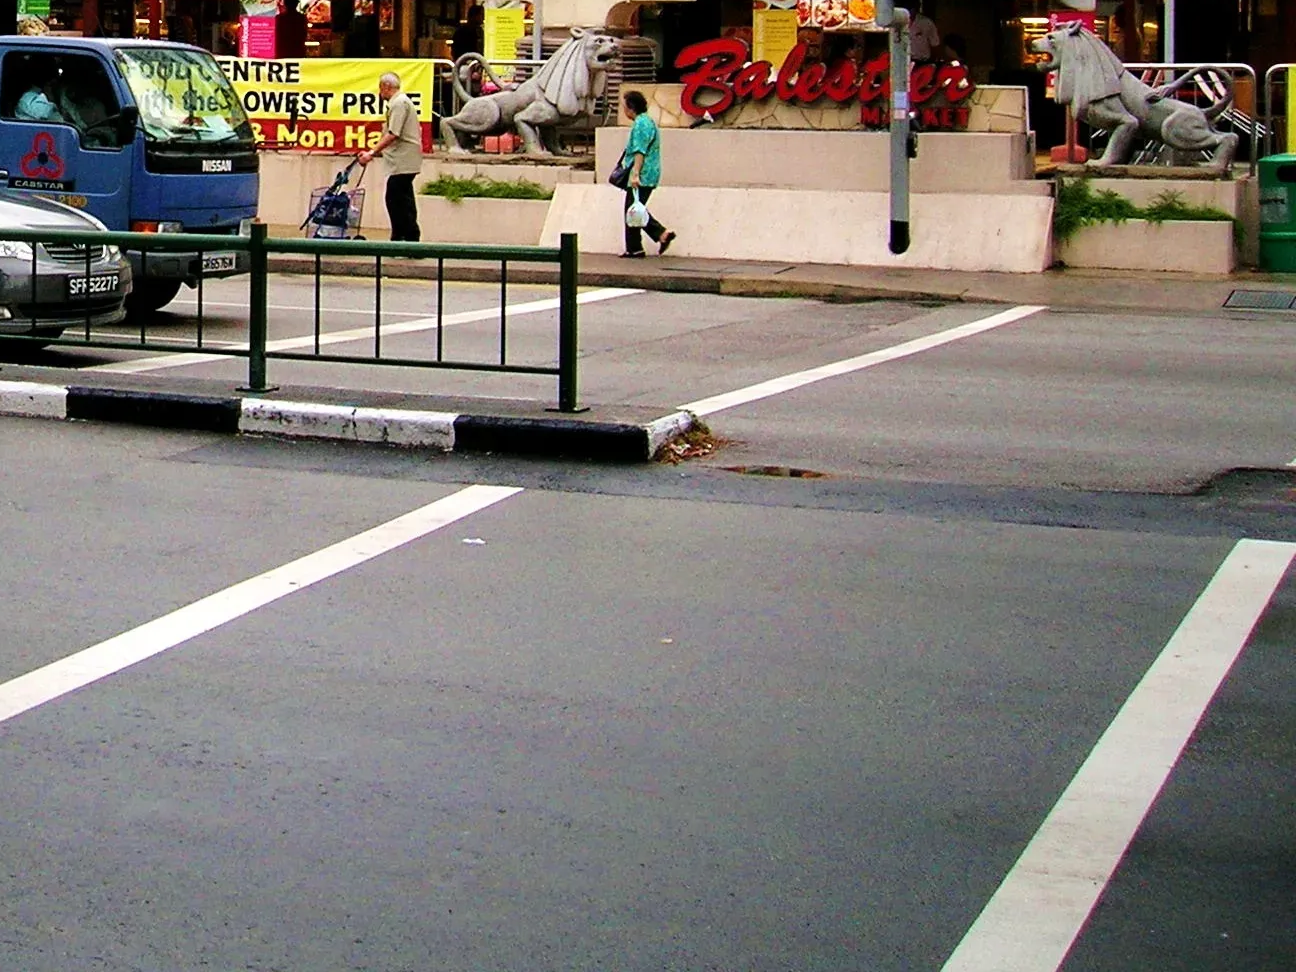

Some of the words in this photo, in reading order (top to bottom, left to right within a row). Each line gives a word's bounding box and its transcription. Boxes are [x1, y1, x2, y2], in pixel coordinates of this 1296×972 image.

[674, 38, 977, 116] Balester
[228, 92, 334, 114] OWEST
[342, 92, 421, 115] PRIE
[861, 107, 970, 126] MKET
[277, 125, 334, 148] Non
[202, 159, 232, 172] NISSAN
[14, 179, 65, 190] CABSTAR
